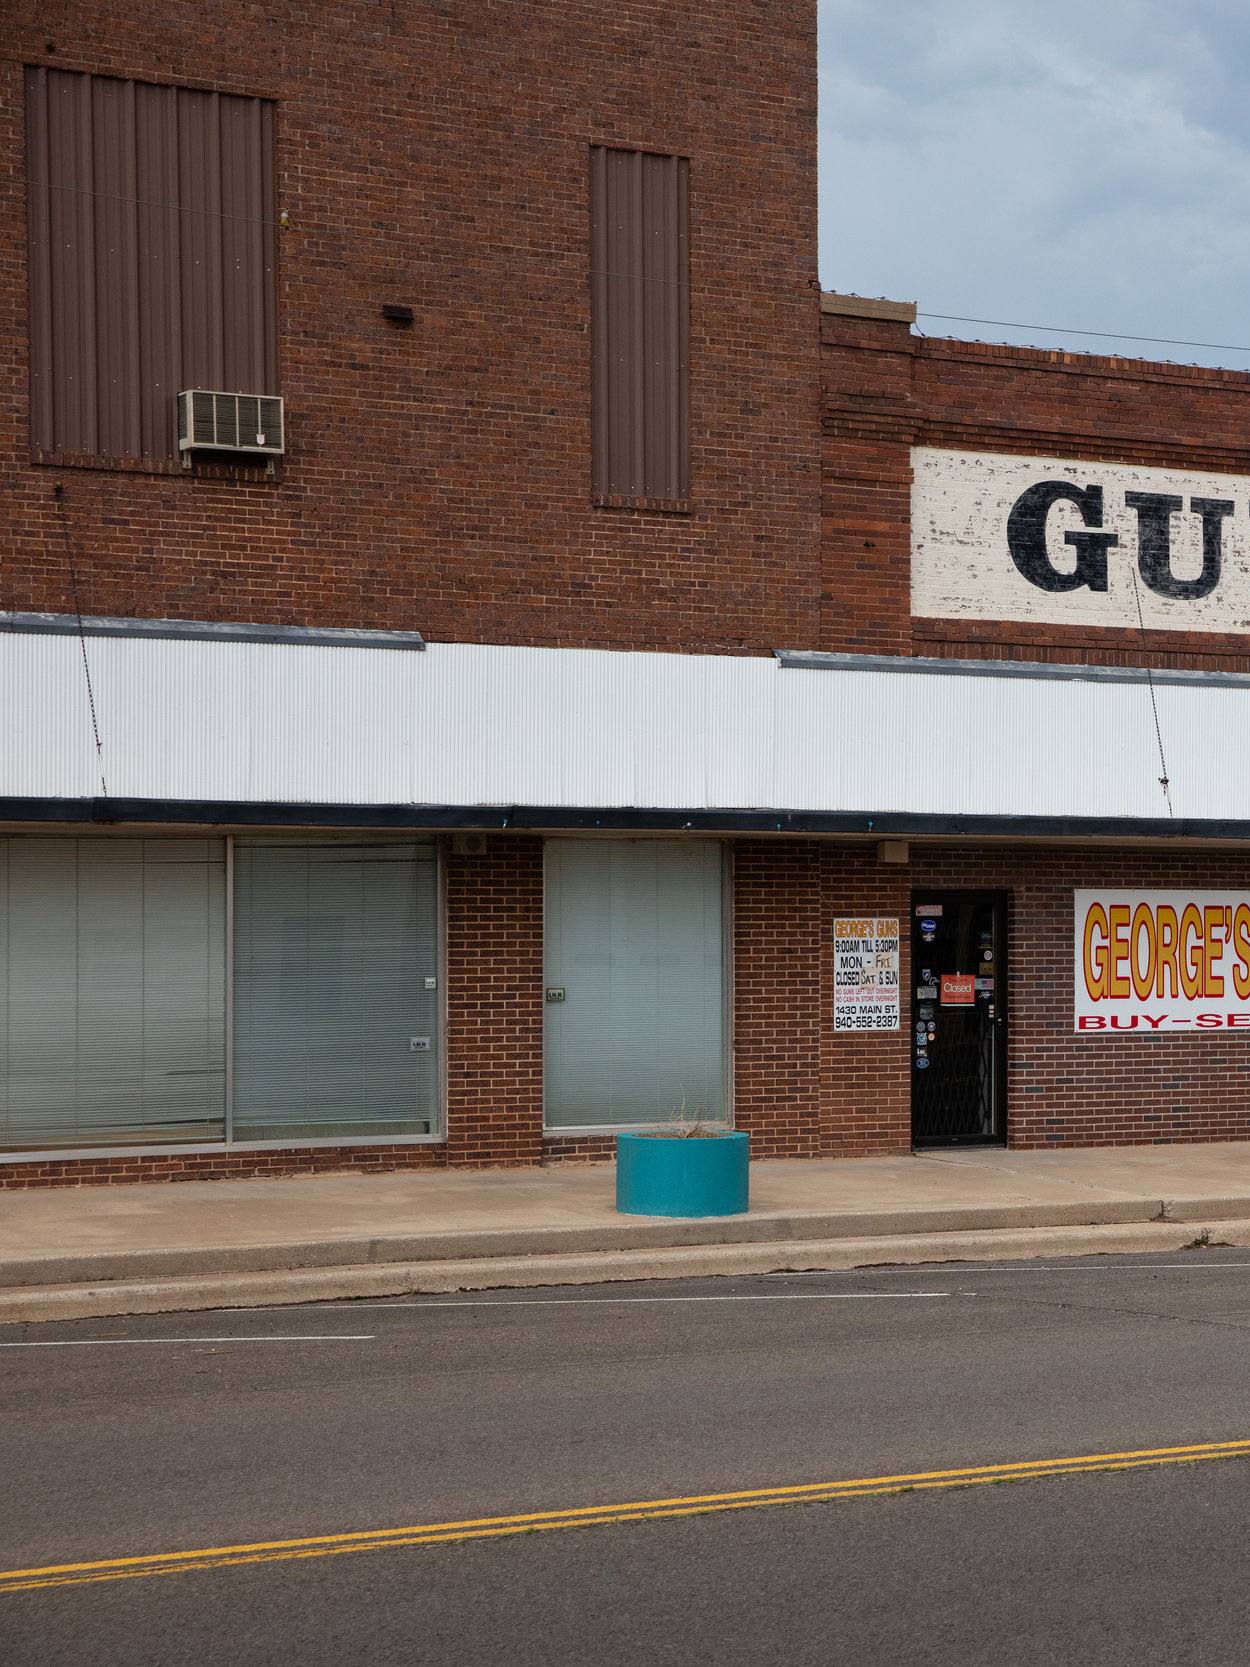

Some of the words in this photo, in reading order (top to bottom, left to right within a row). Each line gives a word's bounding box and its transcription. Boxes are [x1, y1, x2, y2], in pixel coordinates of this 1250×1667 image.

[835, 920, 874, 938] GEORGE'S
[877, 920, 898, 938] GUNS
[836, 940, 859, 953] 9:00AM
[862, 940, 873, 952] TILL
[876, 940, 898, 952] 5:30PM
[841, 957, 862, 968] MON
[836, 972, 859, 985] CLOSED
[879, 971, 883, 985] &
[886, 971, 898, 985] SUN
[944, 982, 972, 992] Closed
[836, 1006, 856, 1014] 1430
[860, 1005, 881, 1014] MAIN
[885, 1005, 897, 1013] ST.
[836, 1016, 898, 1028] 940-552-2387
